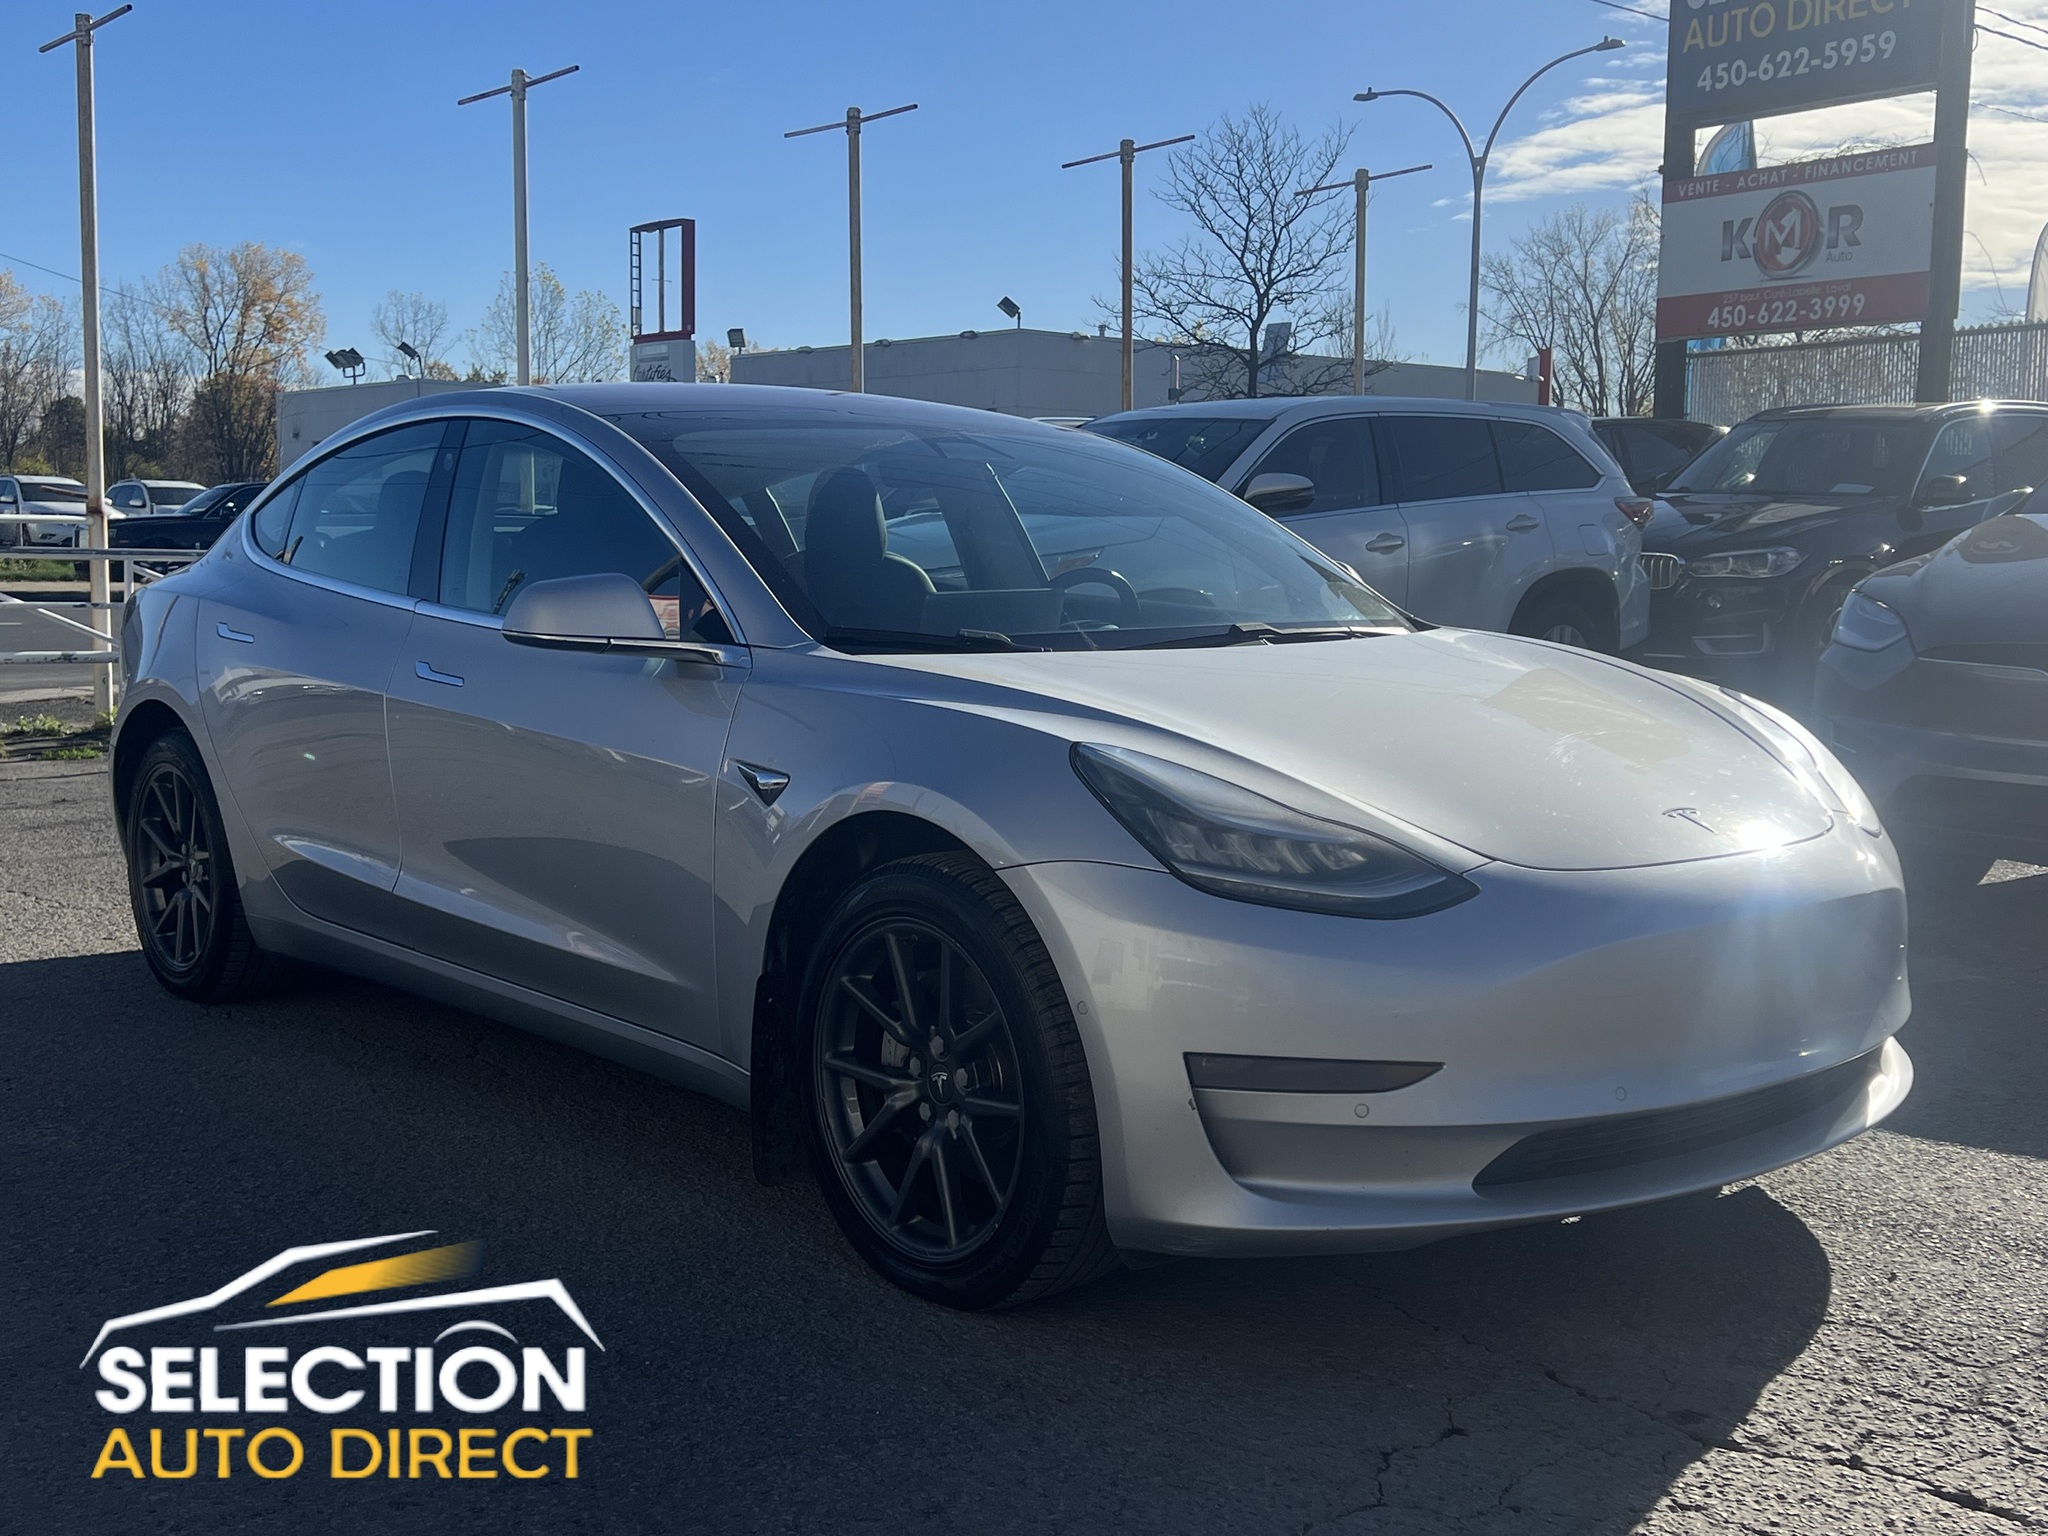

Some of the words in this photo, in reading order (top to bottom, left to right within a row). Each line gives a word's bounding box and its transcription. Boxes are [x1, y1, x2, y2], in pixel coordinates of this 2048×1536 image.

[1682, 2, 1776, 54] AUTO
[1787, 0, 1911, 31] DIRE
[1697, 30, 1896, 92] 450-622-5959
[1678, 178, 1719, 198] VENTE
[1736, 168, 1788, 190] ACHAT
[1804, 150, 1919, 180] FINANCEMENT
[1825, 249, 1853, 263] Auto
[1826, 282, 1851, 293] Laval
[1707, 293, 1866, 328] 450-622-3999
